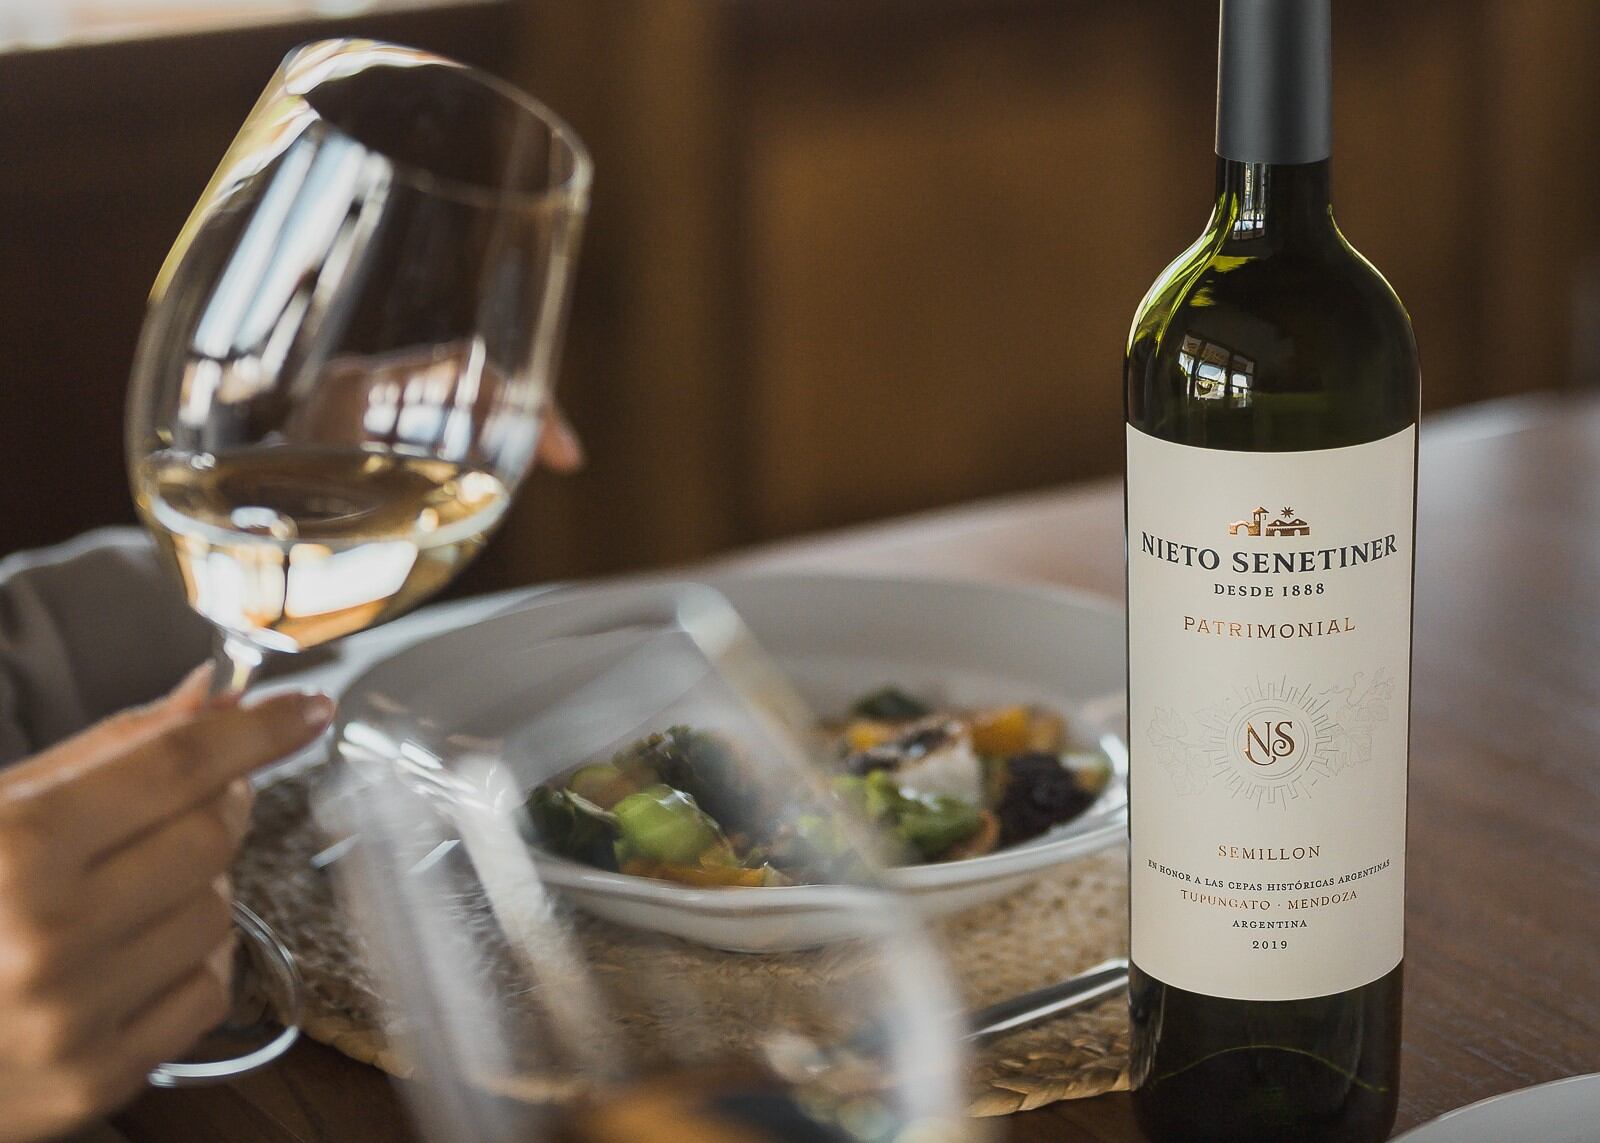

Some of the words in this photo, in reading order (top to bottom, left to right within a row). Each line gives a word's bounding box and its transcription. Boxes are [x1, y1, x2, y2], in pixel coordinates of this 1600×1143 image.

[1141, 531, 1220, 570] NIETO
[1232, 533, 1398, 574] SENETINER
[1213, 583, 1274, 597] DESDE
[1282, 583, 1325, 597] 1888
[1183, 615, 1356, 639] PATRIMONIAL
[1243, 721, 1295, 765] NS
[1218, 845, 1321, 861] SEMILLON
[1148, 859, 1157, 870] EN
[1159, 864, 1191, 882] HONOR
[1194, 876, 1202, 885] A
[1205, 878, 1224, 888] LAS
[1228, 881, 1262, 891] CEPAS
[1267, 878, 1335, 891] HISTÓRICAS
[1338, 859, 1390, 885] ARGENTINAS
[1180, 889, 1271, 911] TUPUNGATO
[1288, 890, 1358, 910] MENDOZA
[1232, 919, 1308, 929] ARGENTINA
[1252, 940, 1288, 950] 2019
